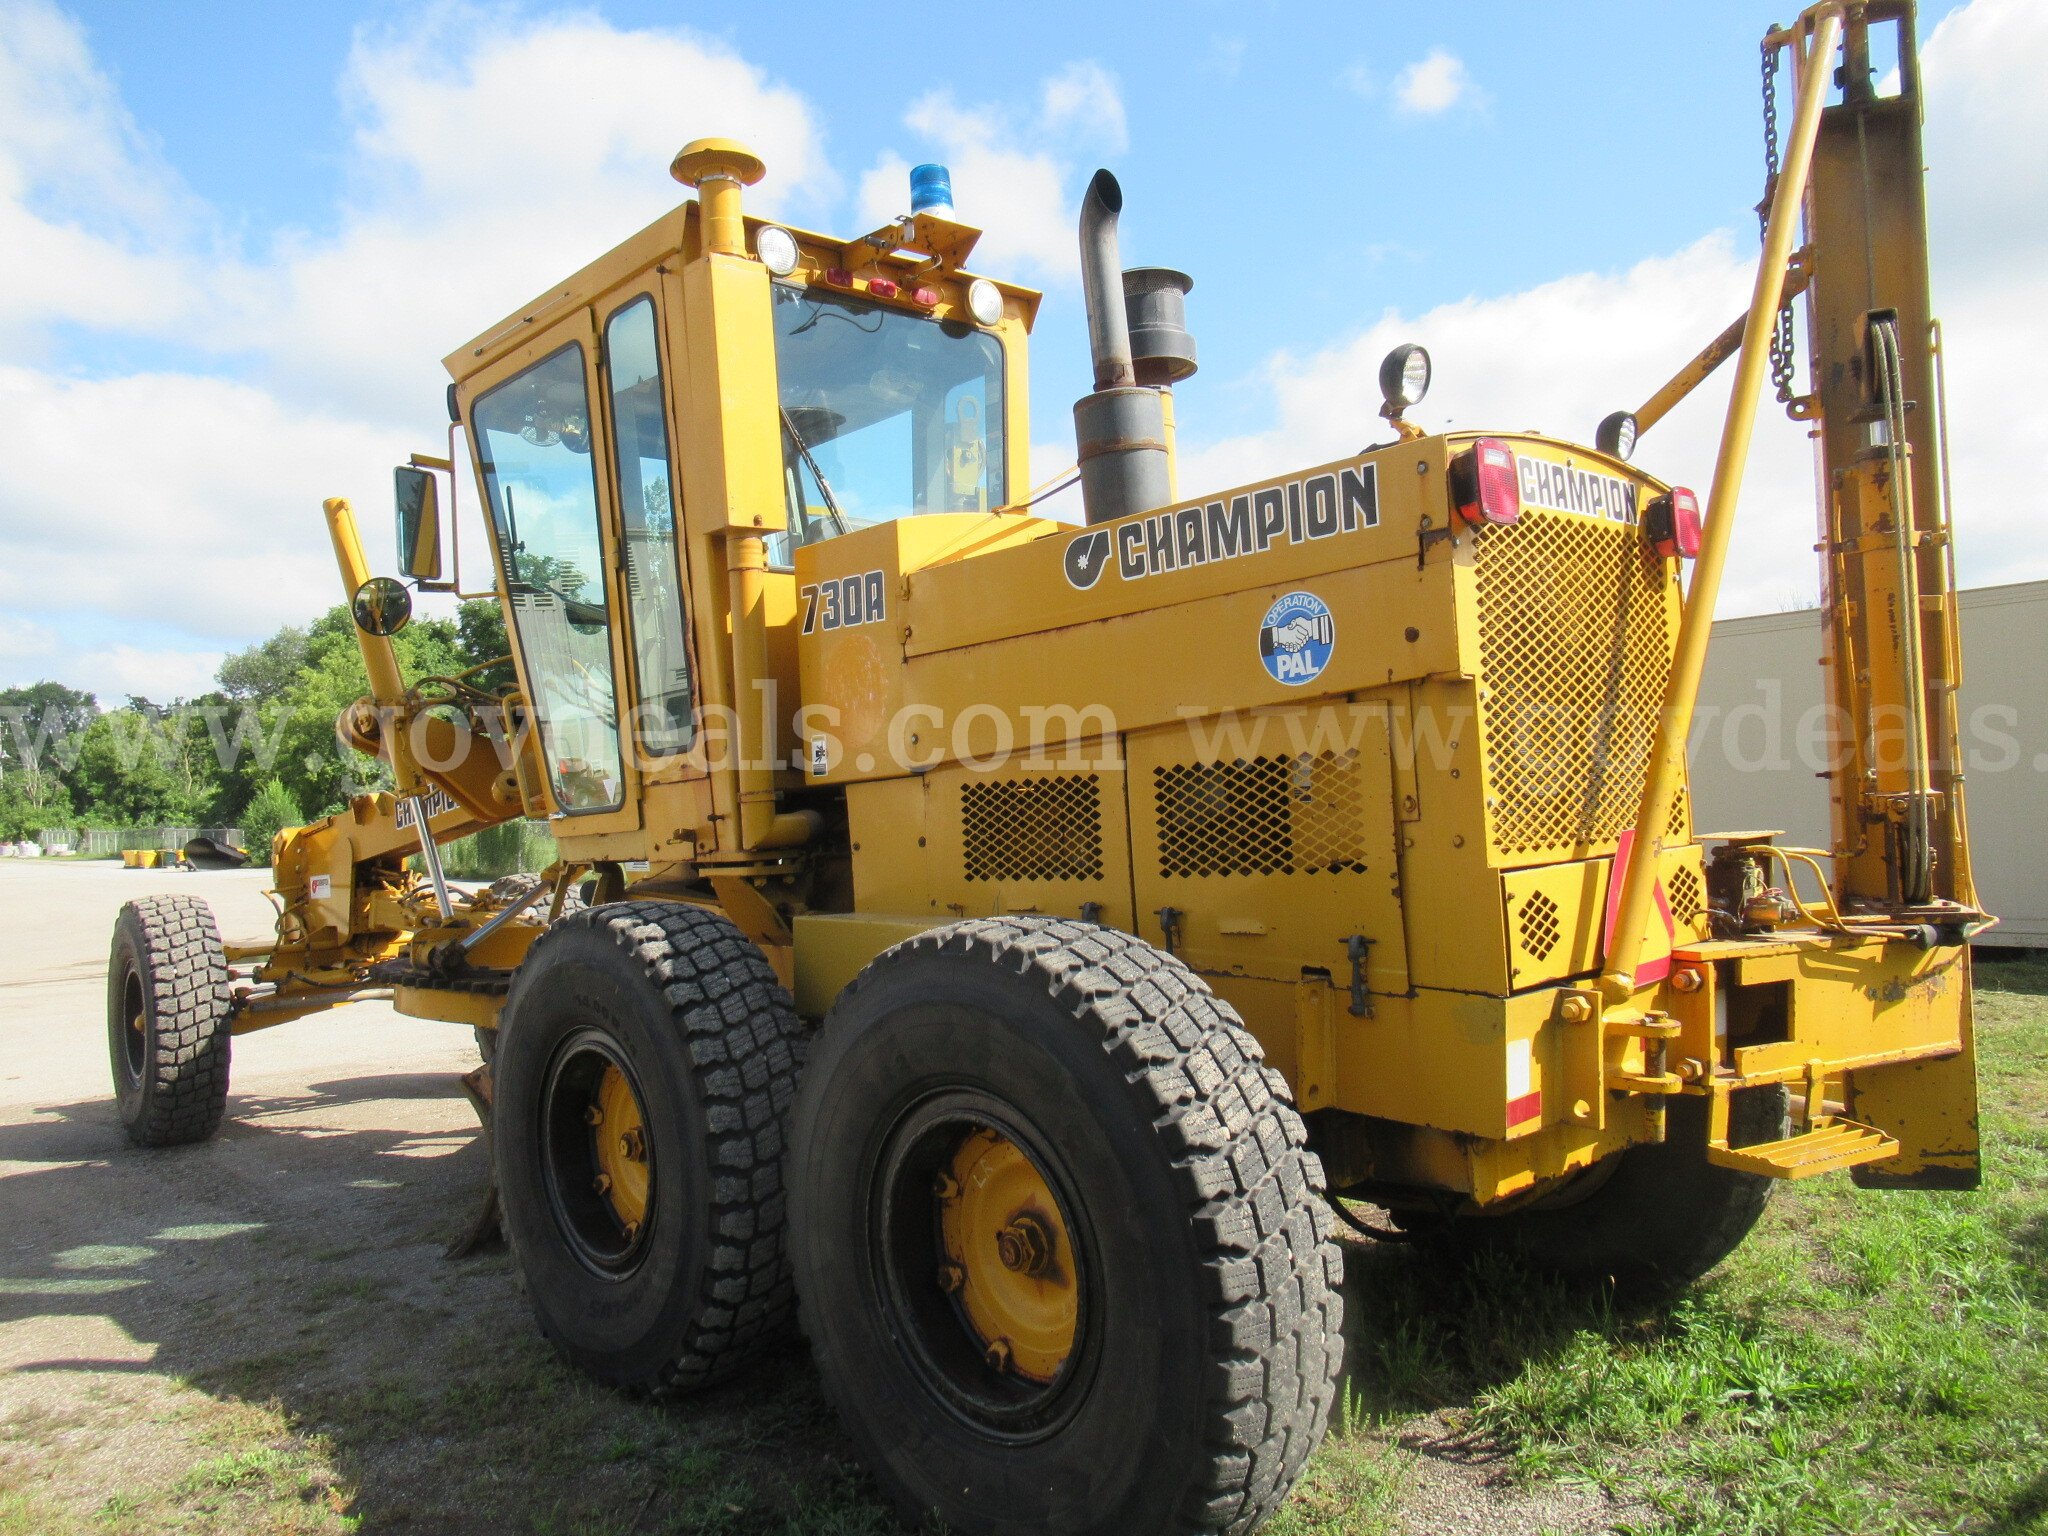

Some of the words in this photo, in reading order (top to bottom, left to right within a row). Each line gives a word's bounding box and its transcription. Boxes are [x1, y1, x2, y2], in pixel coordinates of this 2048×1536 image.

[1117, 461, 1380, 581] CHAMPION
[1517, 455, 1639, 527] CHAMPION
[801, 569, 886, 636] 730A
[1267, 594, 1322, 625] OPERATION
[1276, 649, 1320, 680] PAL
